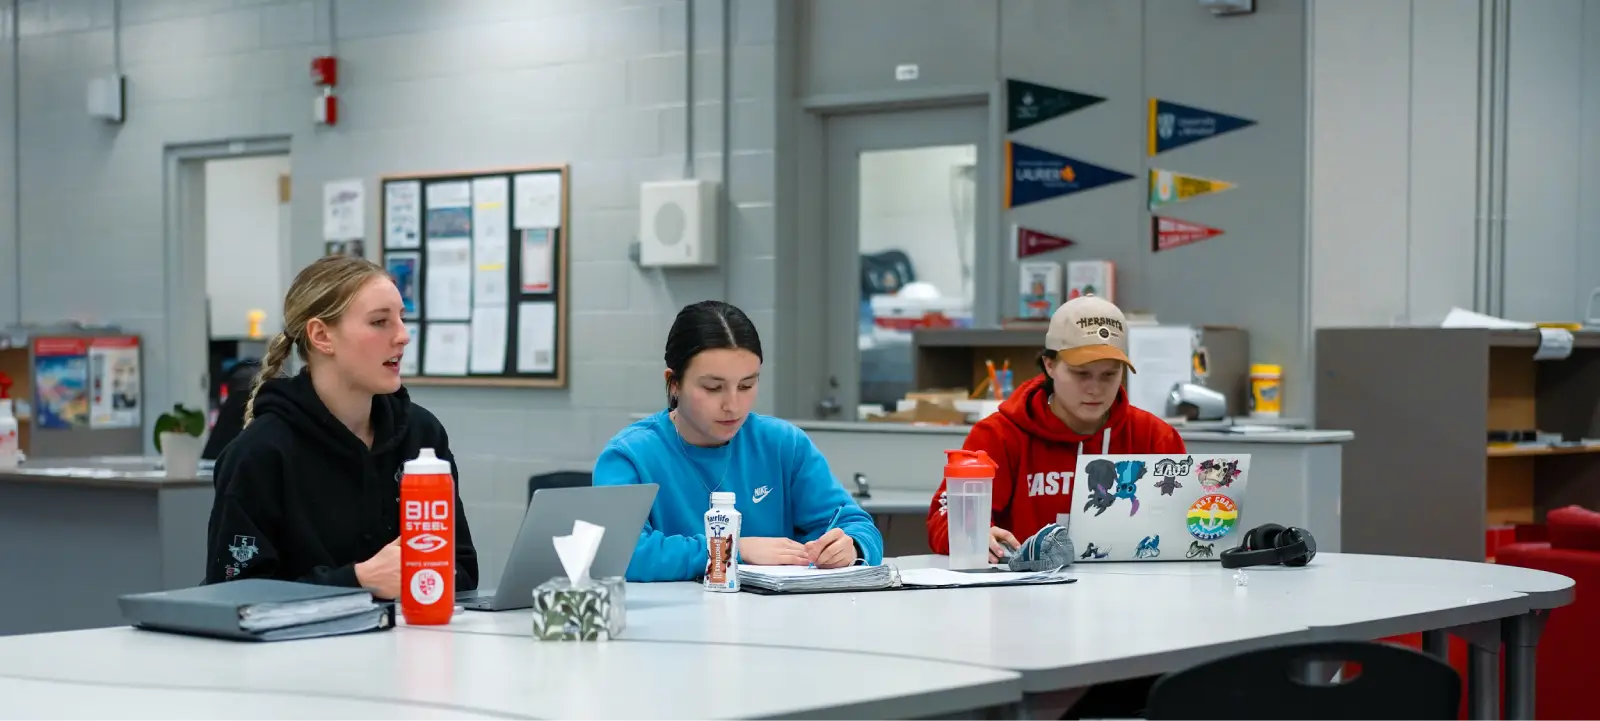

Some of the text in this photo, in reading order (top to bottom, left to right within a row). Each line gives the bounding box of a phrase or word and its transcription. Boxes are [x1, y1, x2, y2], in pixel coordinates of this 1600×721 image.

[754, 485, 768, 497] NIKE
[405, 501, 449, 520] BIO
[405, 521, 449, 531] STEEL
